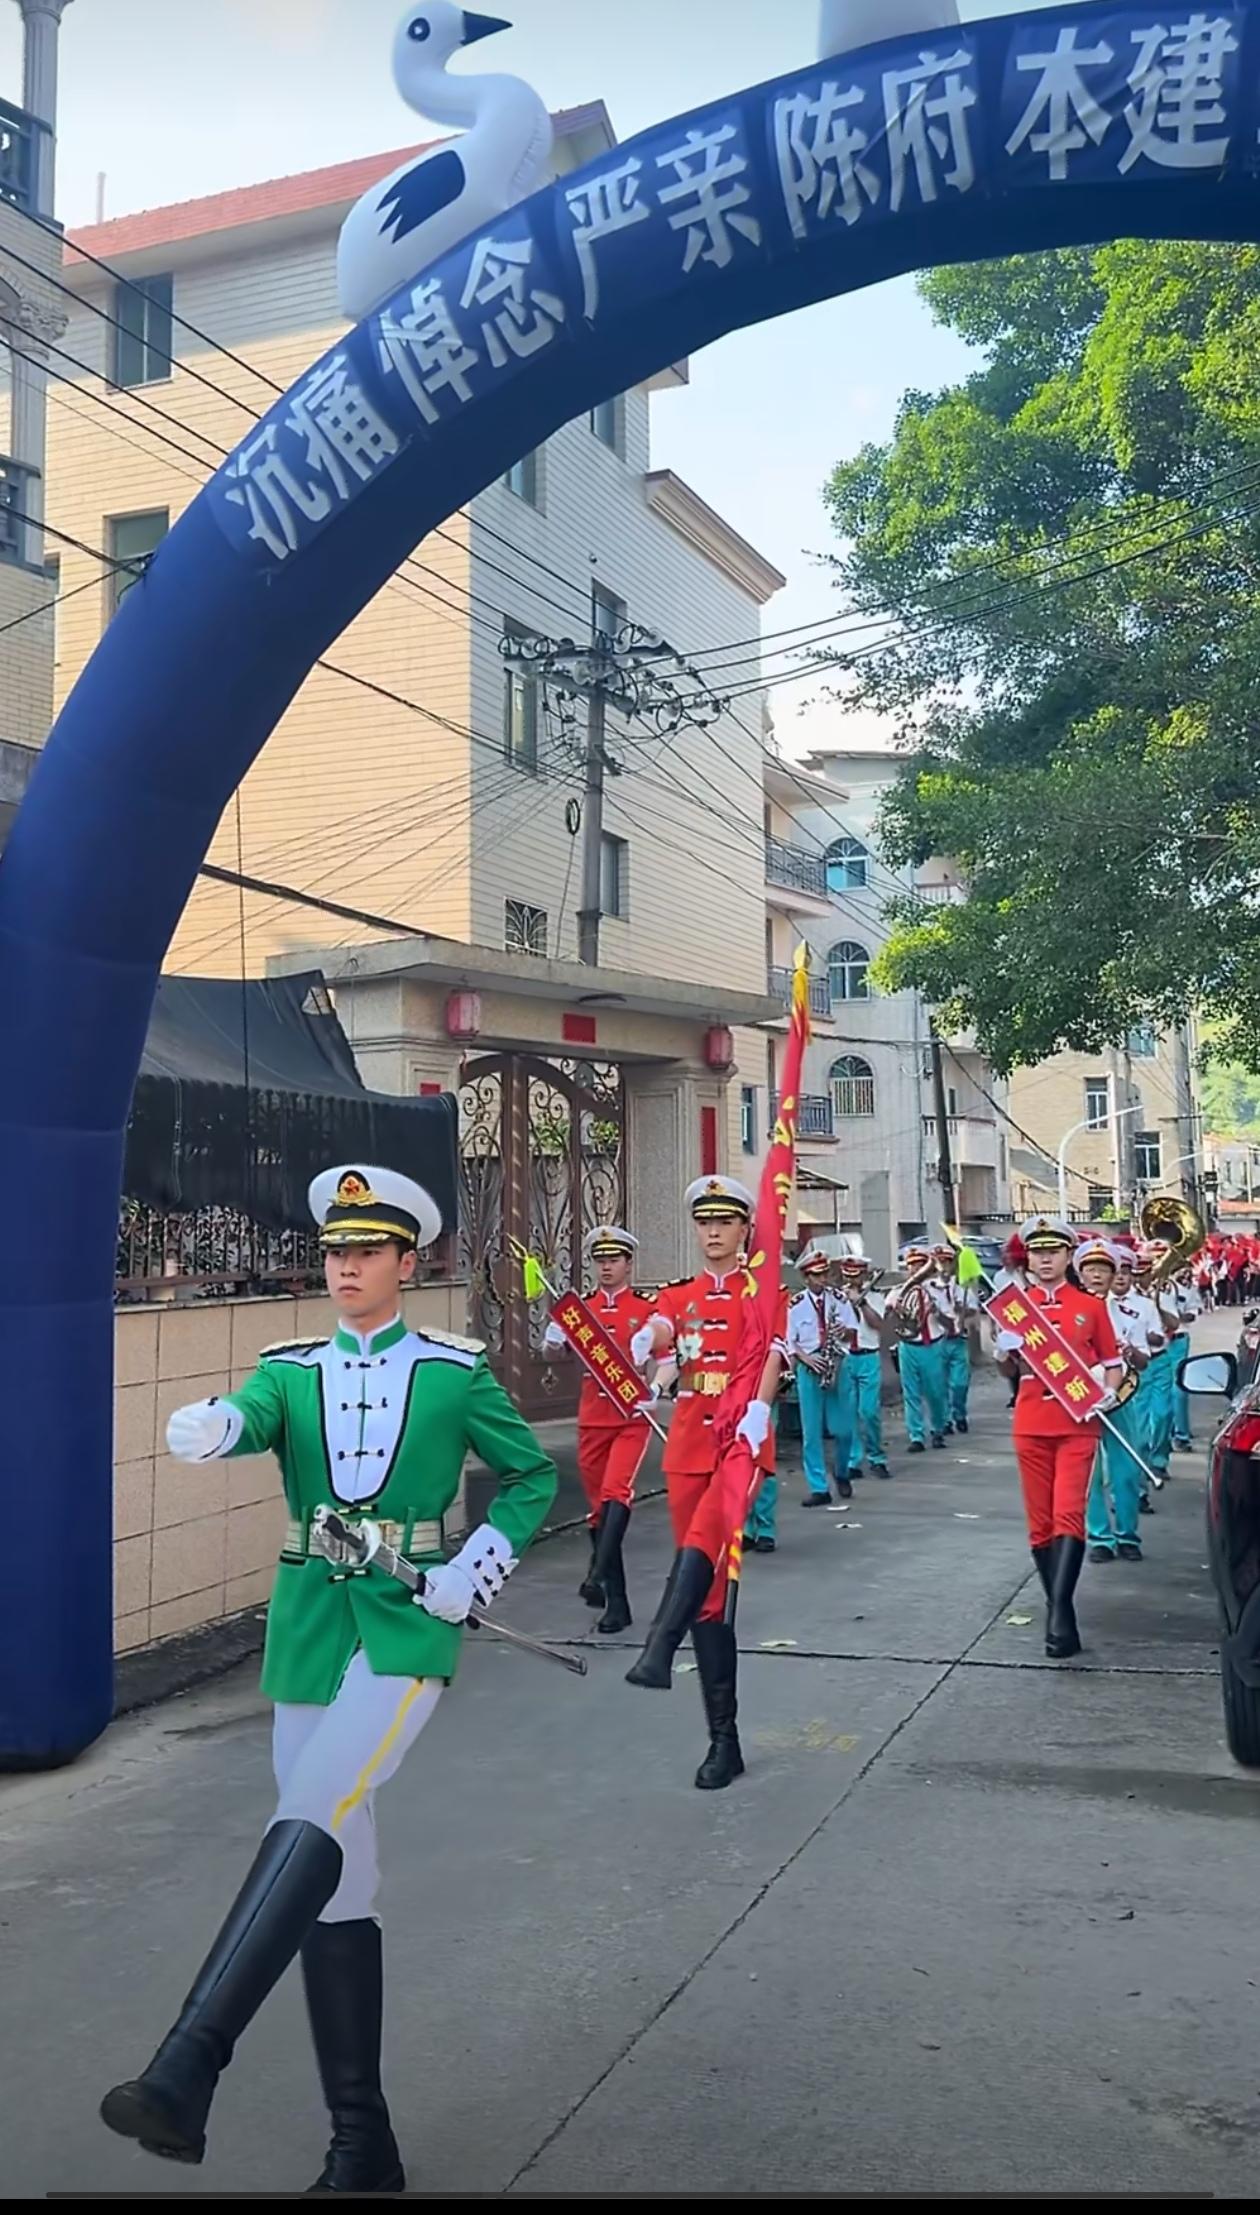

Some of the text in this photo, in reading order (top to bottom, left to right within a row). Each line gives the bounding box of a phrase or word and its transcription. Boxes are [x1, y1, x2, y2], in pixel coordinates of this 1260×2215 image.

[561, 1306, 640, 1403] 好声音乐团
[1002, 1300, 1091, 1402] 福州建新
